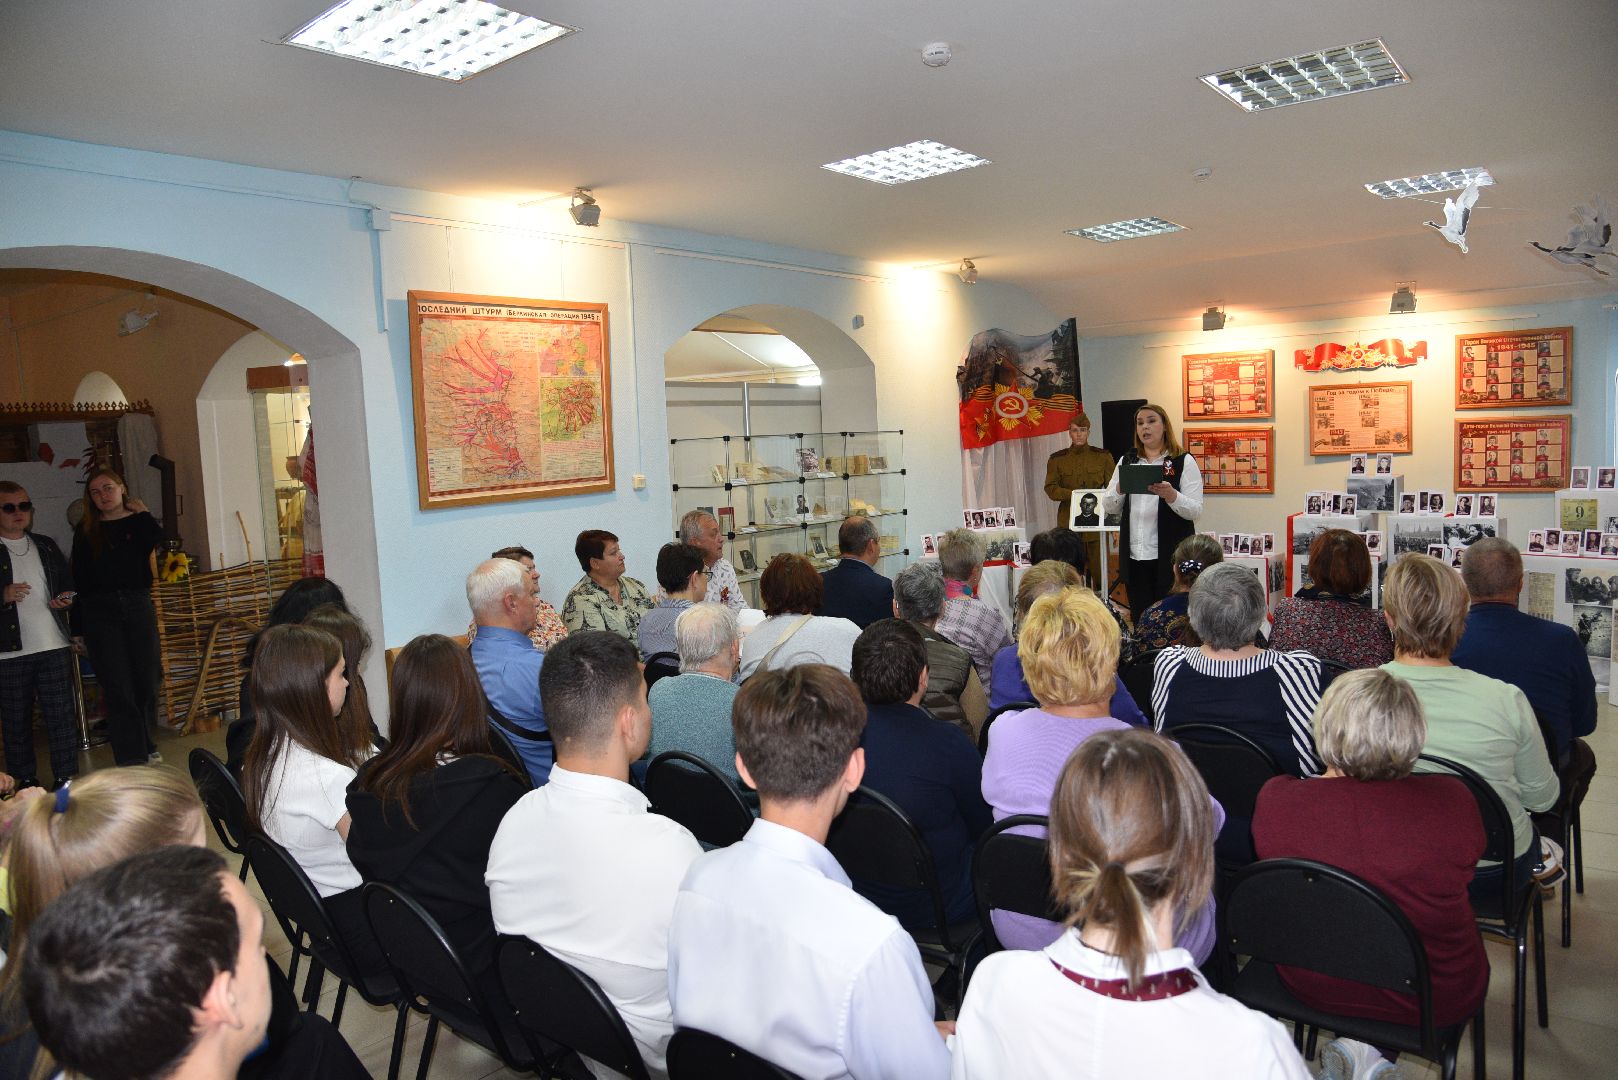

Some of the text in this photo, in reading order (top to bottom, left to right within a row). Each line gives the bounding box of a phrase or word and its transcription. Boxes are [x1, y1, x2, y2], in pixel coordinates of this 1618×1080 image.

[472, 307, 502, 315] ШТУРМ
[1496, 342, 1536, 350] 1941-1945
[1575, 505, 1585, 521] 9
